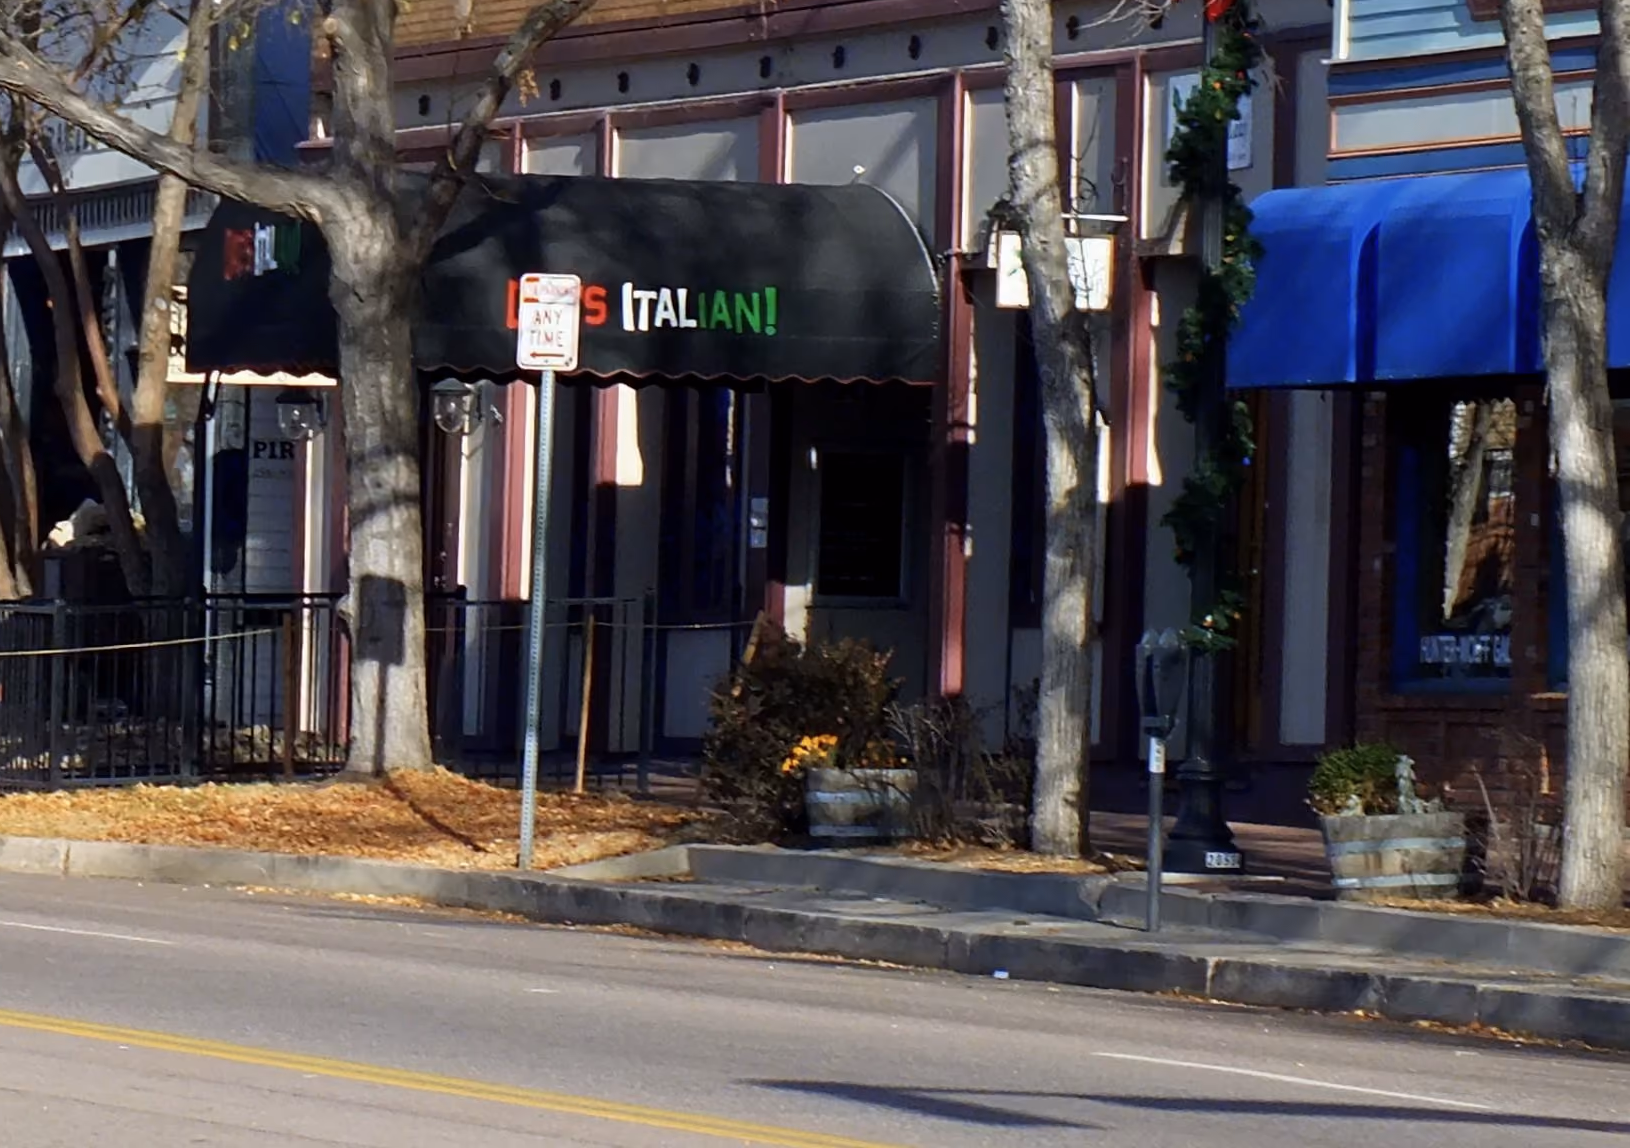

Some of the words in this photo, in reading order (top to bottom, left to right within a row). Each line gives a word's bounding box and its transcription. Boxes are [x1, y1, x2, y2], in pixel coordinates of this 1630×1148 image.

[533, 310, 563, 325] ANY
[622, 282, 777, 336] ITALIAN!
[530, 330, 564, 347] TIME
